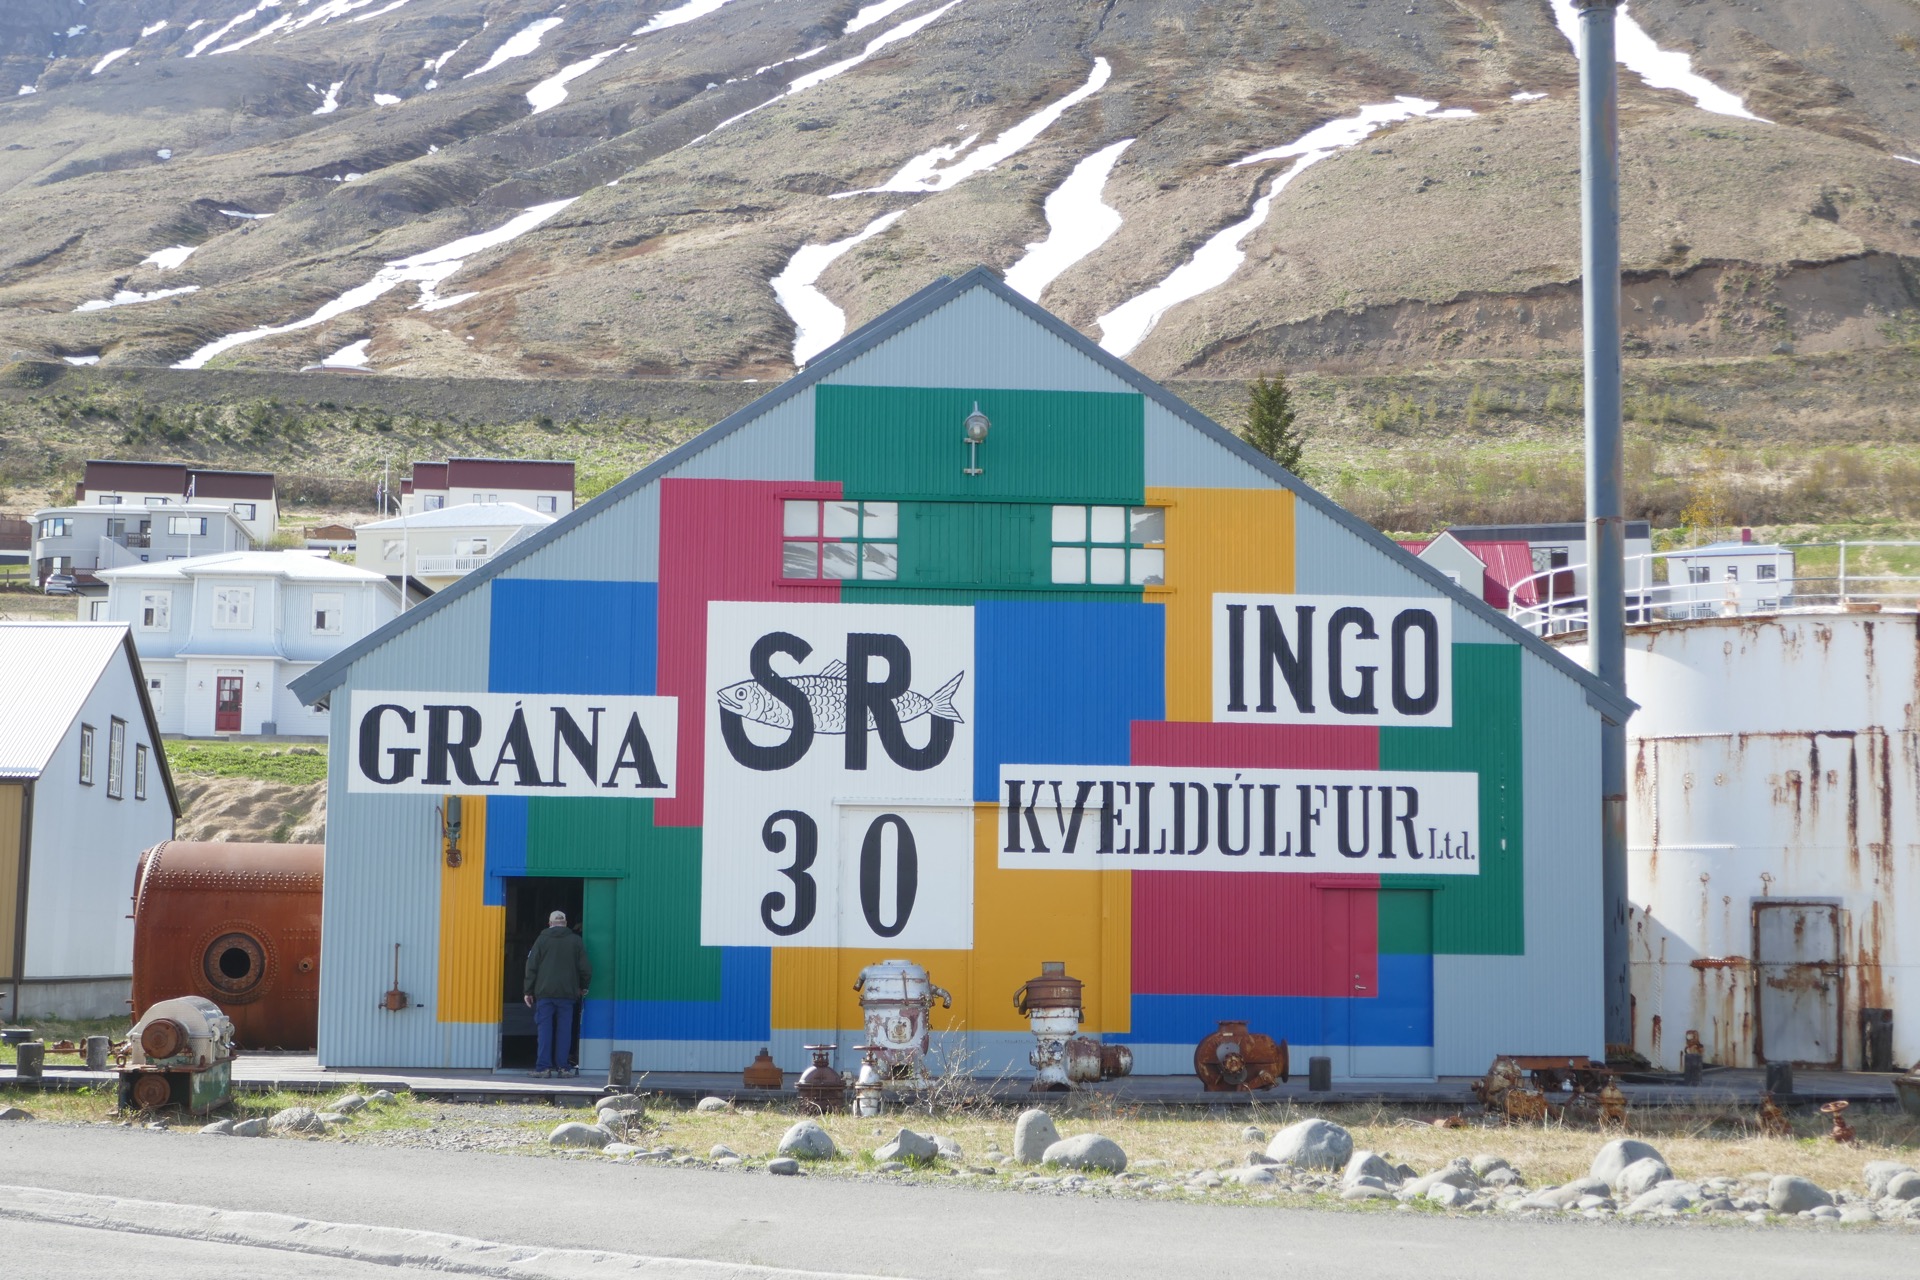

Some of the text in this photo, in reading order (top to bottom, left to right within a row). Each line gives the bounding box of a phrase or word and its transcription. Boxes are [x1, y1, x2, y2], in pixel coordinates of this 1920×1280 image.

[720, 631, 955, 771] SR
[1226, 604, 1439, 715] INGO
[359, 701, 668, 788] GRÁNA
[1003, 773, 1477, 860] KVELDÚLFUR Ltd.
